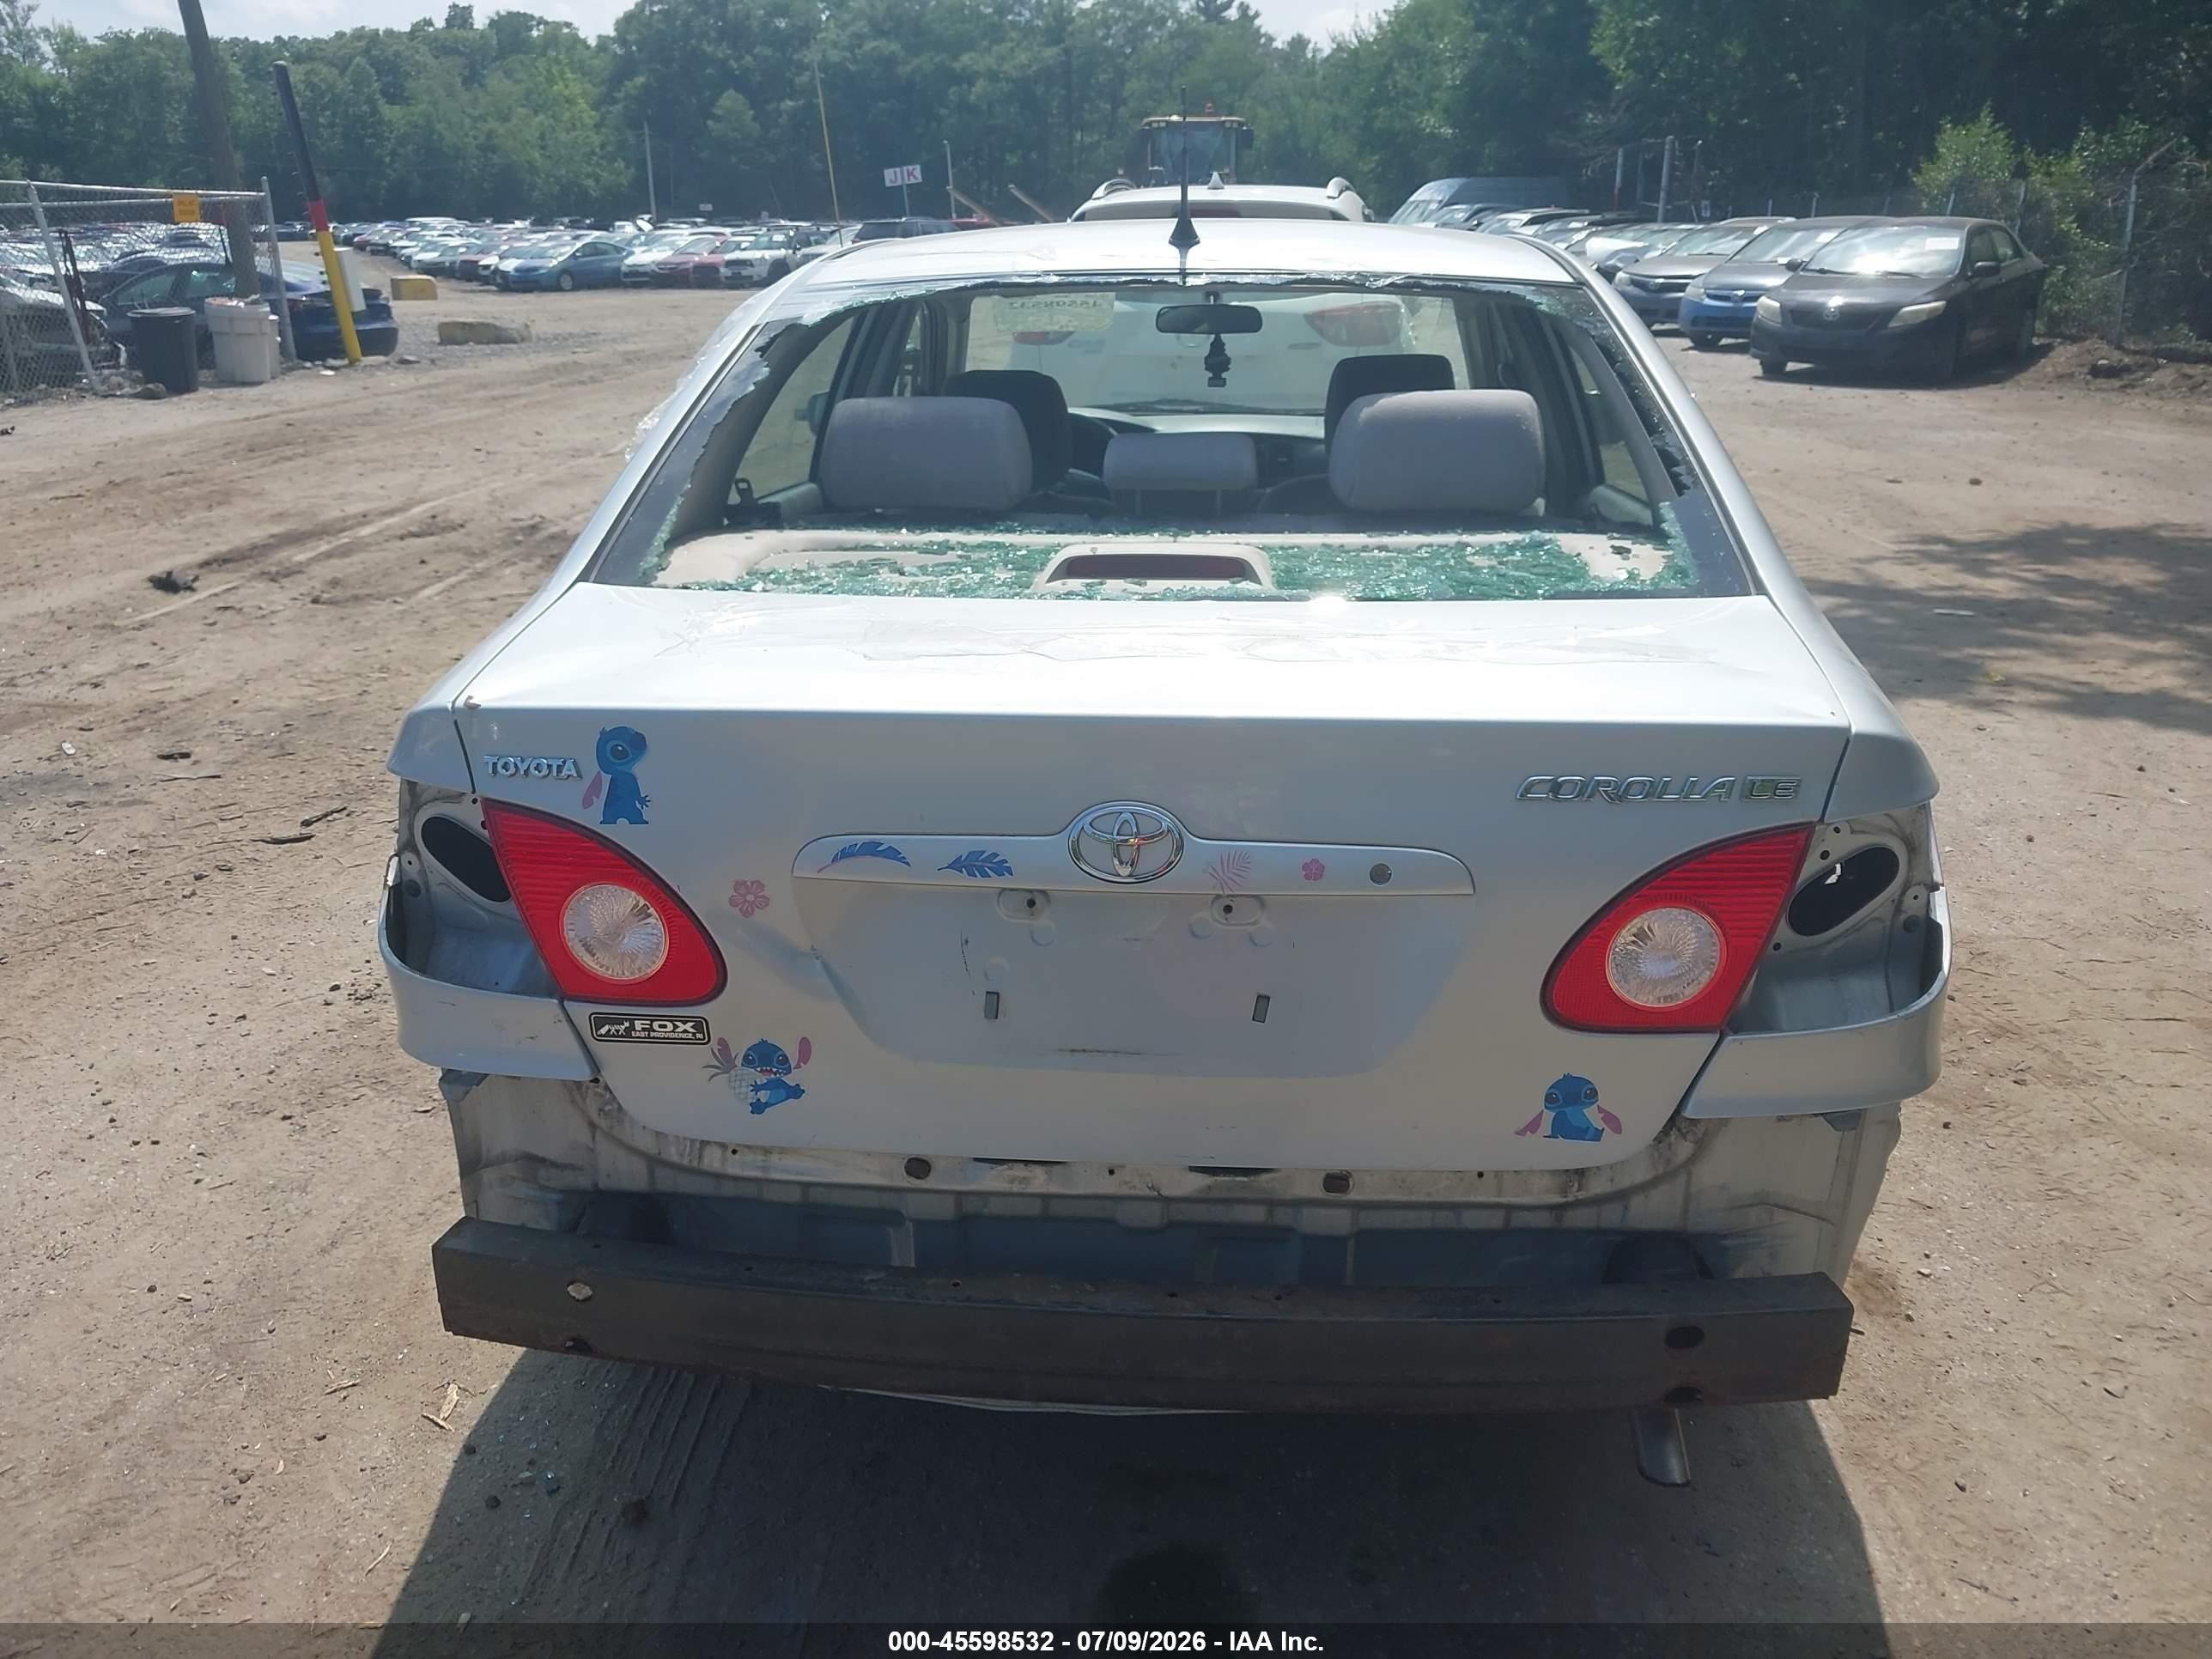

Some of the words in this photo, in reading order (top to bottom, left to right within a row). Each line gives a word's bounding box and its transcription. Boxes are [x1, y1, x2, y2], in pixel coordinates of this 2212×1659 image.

[889, 170, 898, 184] J
[906, 167, 918, 181] K
[482, 756, 582, 779] TOYOTA
[1516, 775, 1736, 803] COROLLA
[1747, 776, 1801, 801] LE
[634, 1020, 697, 1033] FOX
